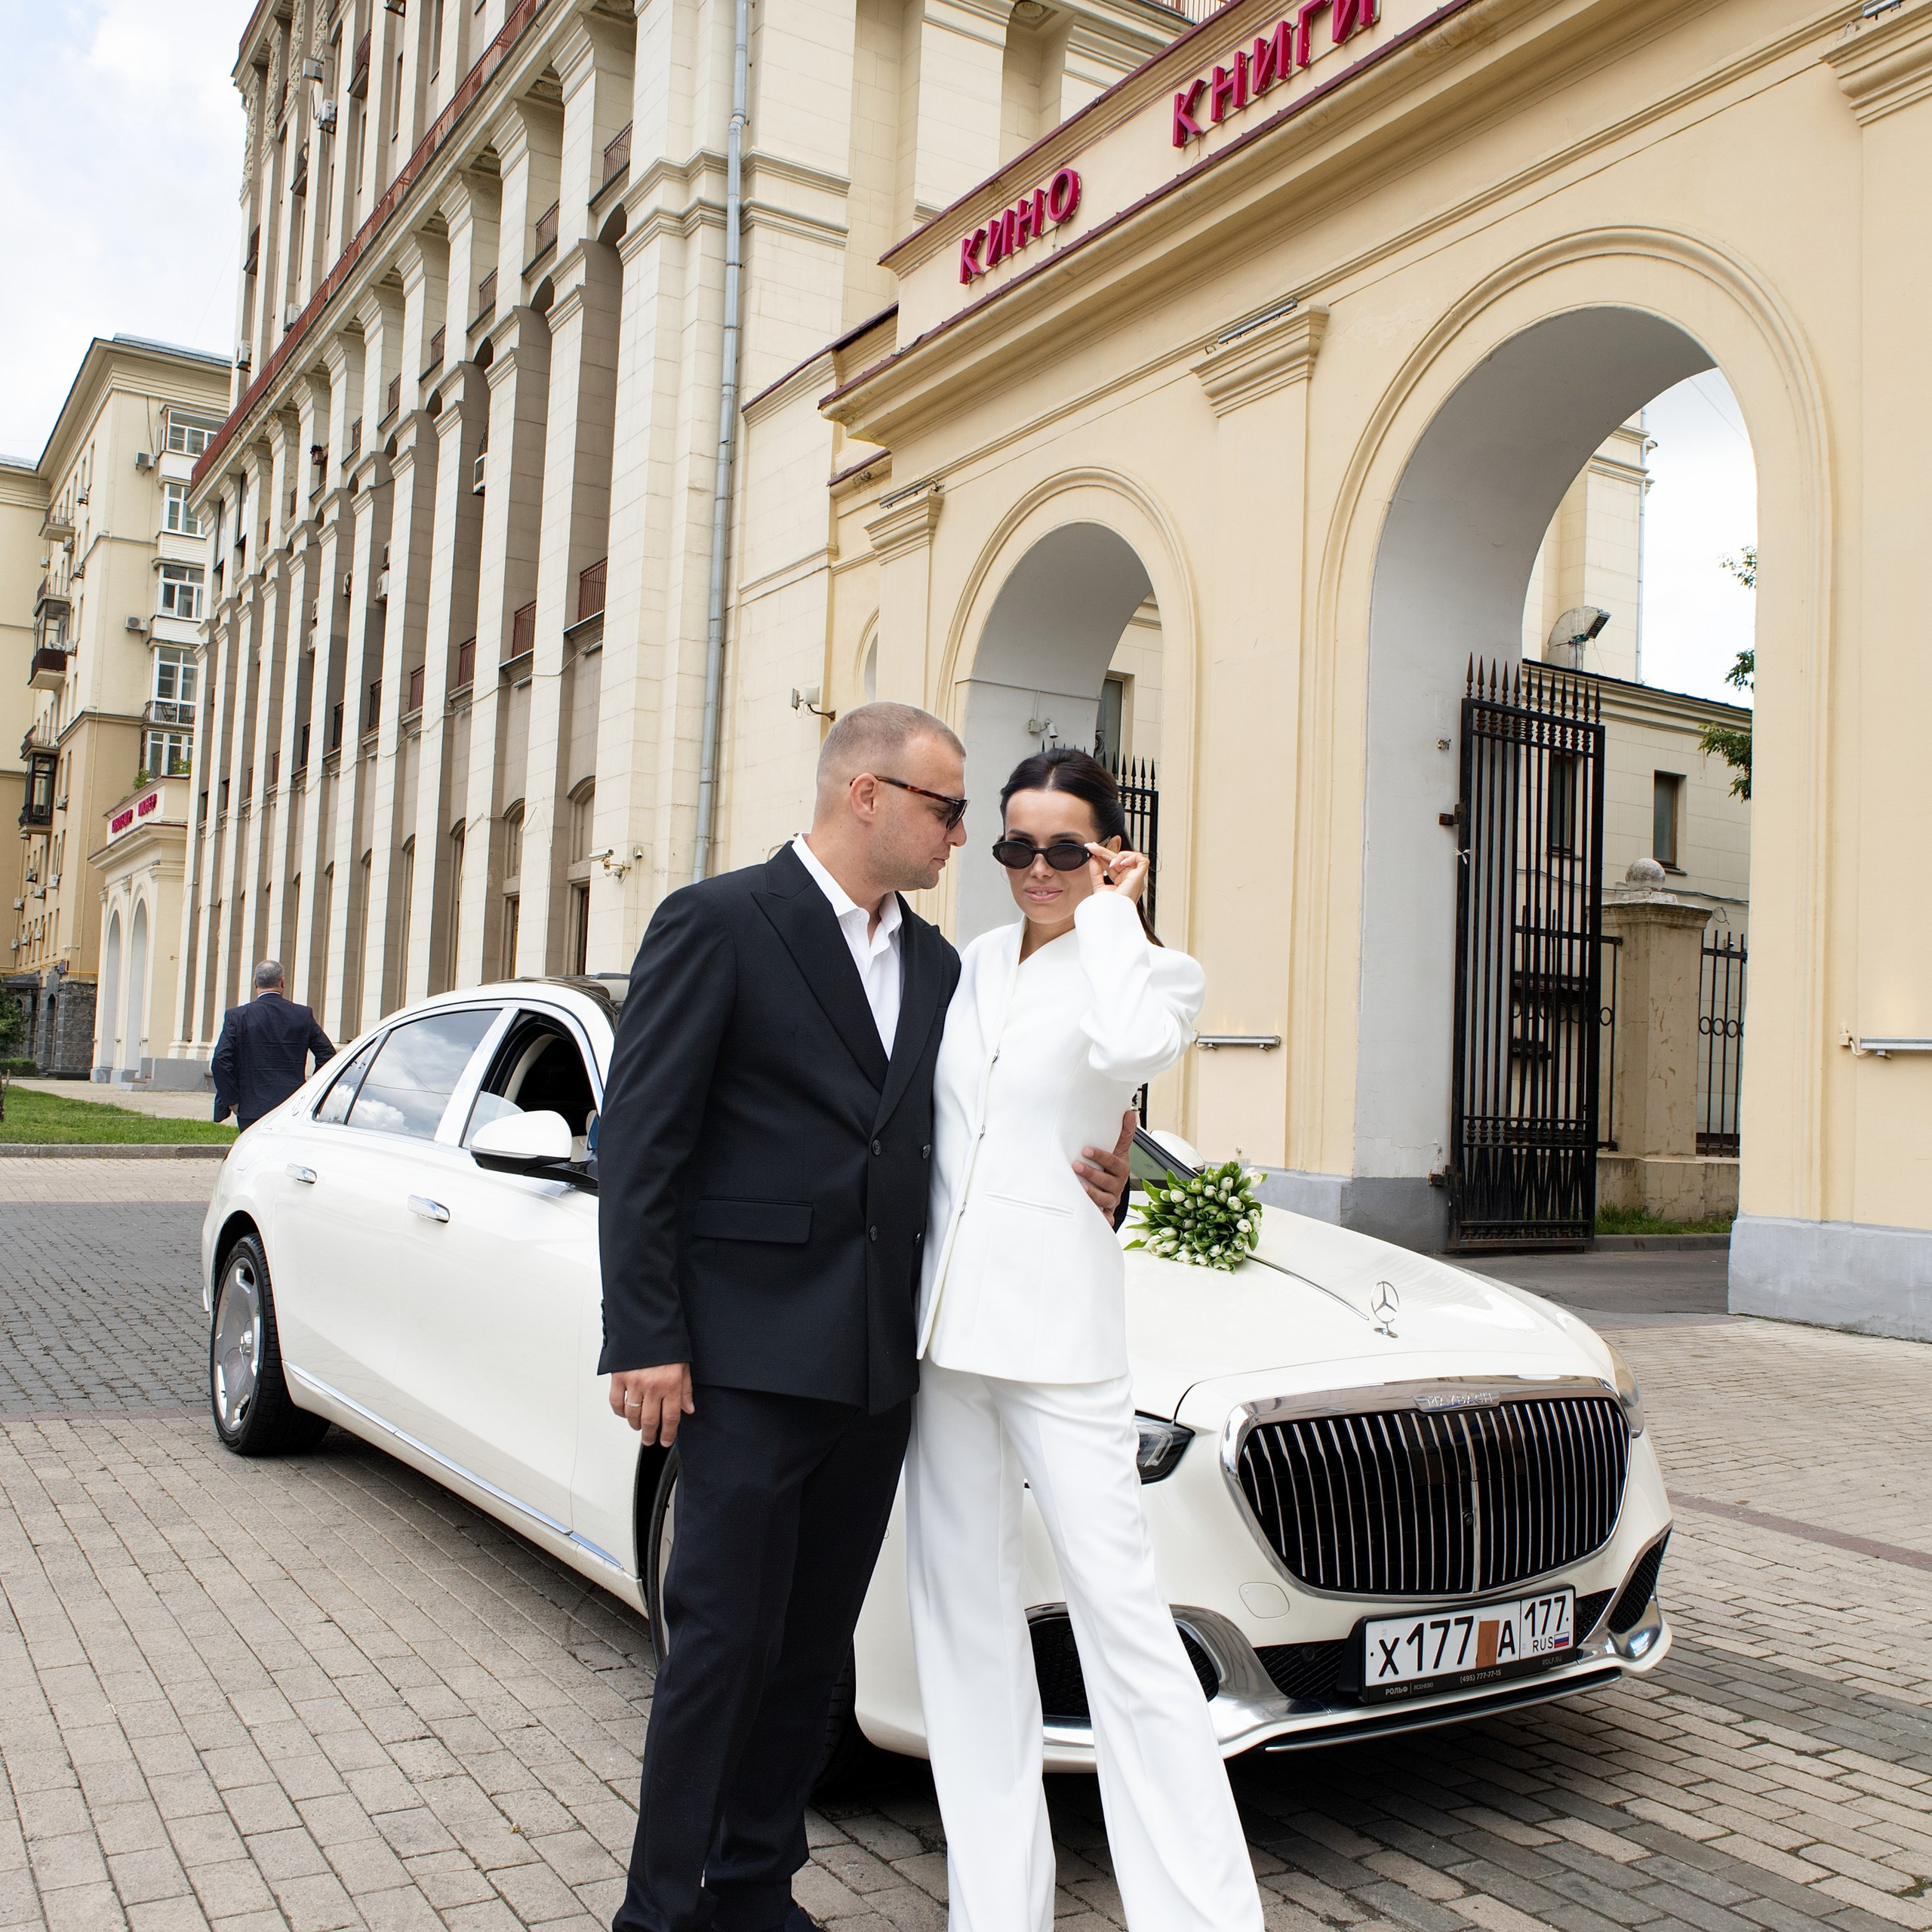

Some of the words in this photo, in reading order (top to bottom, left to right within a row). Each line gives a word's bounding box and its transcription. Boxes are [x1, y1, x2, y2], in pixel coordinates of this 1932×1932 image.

[959, 168, 1081, 285] КИНО
[1172, 0, 1375, 149] КНИГИ
[1426, 1392, 1493, 1407] MAYBACH
[1378, 1615, 1515, 1677] Х177А
[1524, 1595, 1566, 1638] 177
[1532, 1635, 1553, 1653] RUS
[1542, 1655, 1562, 1666] ROLF.RU
[1460, 1675, 1475, 1684] (495)
[1476, 1669, 1501, 1681] 777-77-15
[1385, 1686, 1408, 1696] РОЛЬФ
